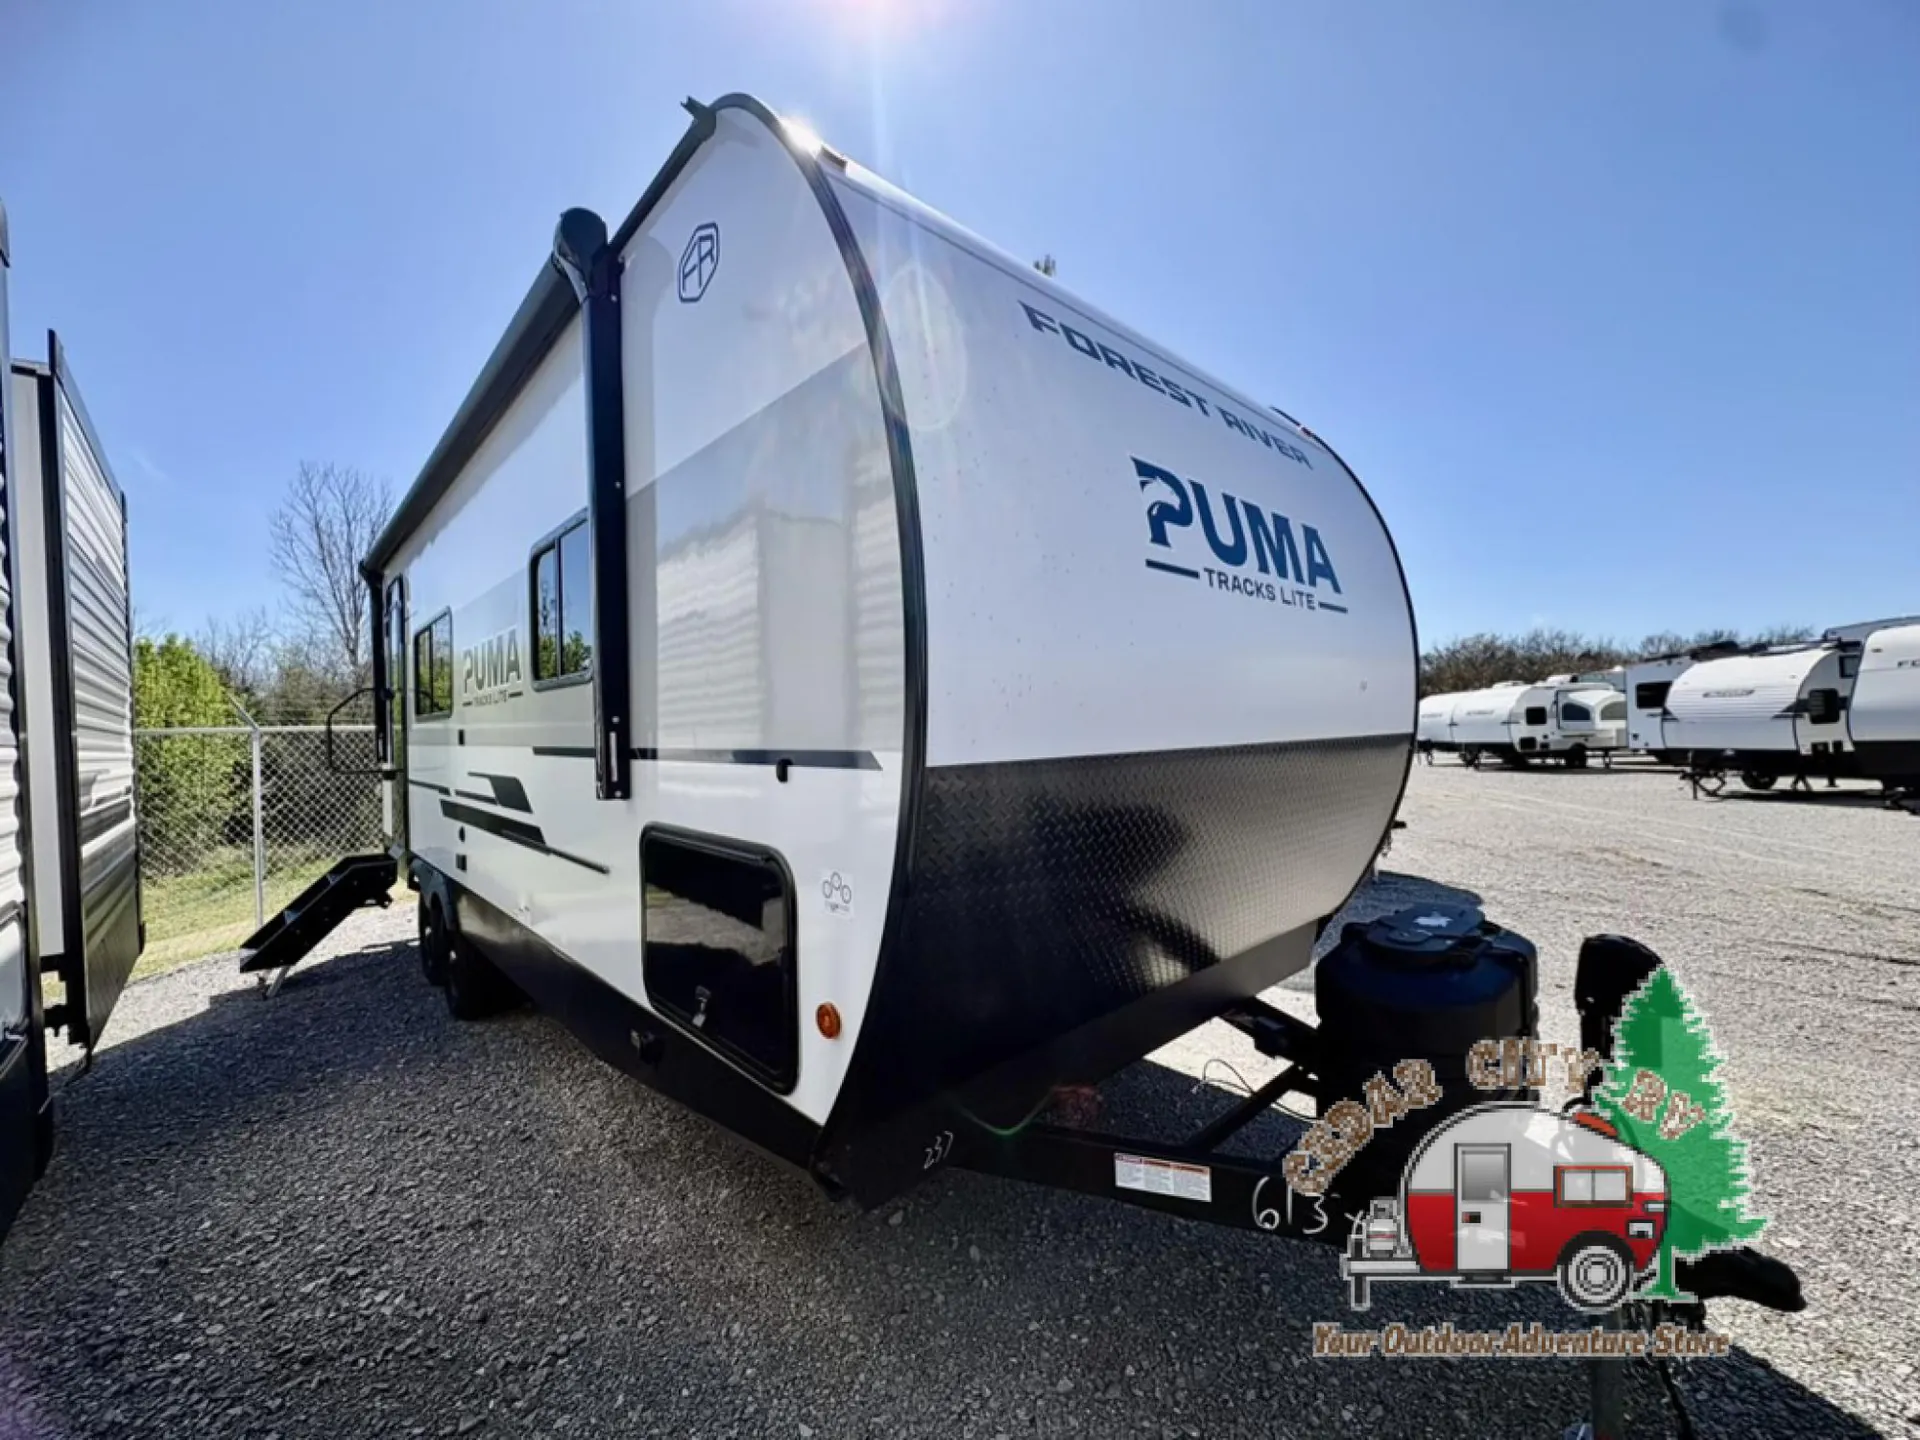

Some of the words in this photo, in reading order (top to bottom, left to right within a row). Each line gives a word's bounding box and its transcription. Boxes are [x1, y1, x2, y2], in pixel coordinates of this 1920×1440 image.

[1017, 299, 1210, 417] FOREST
[1214, 404, 1313, 470] RIVER
[1129, 455, 1343, 595] PUMA
[1203, 567, 1276, 601] TRACKS
[1281, 586, 1316, 611] LITE
[462, 627, 521, 694] PUMA
